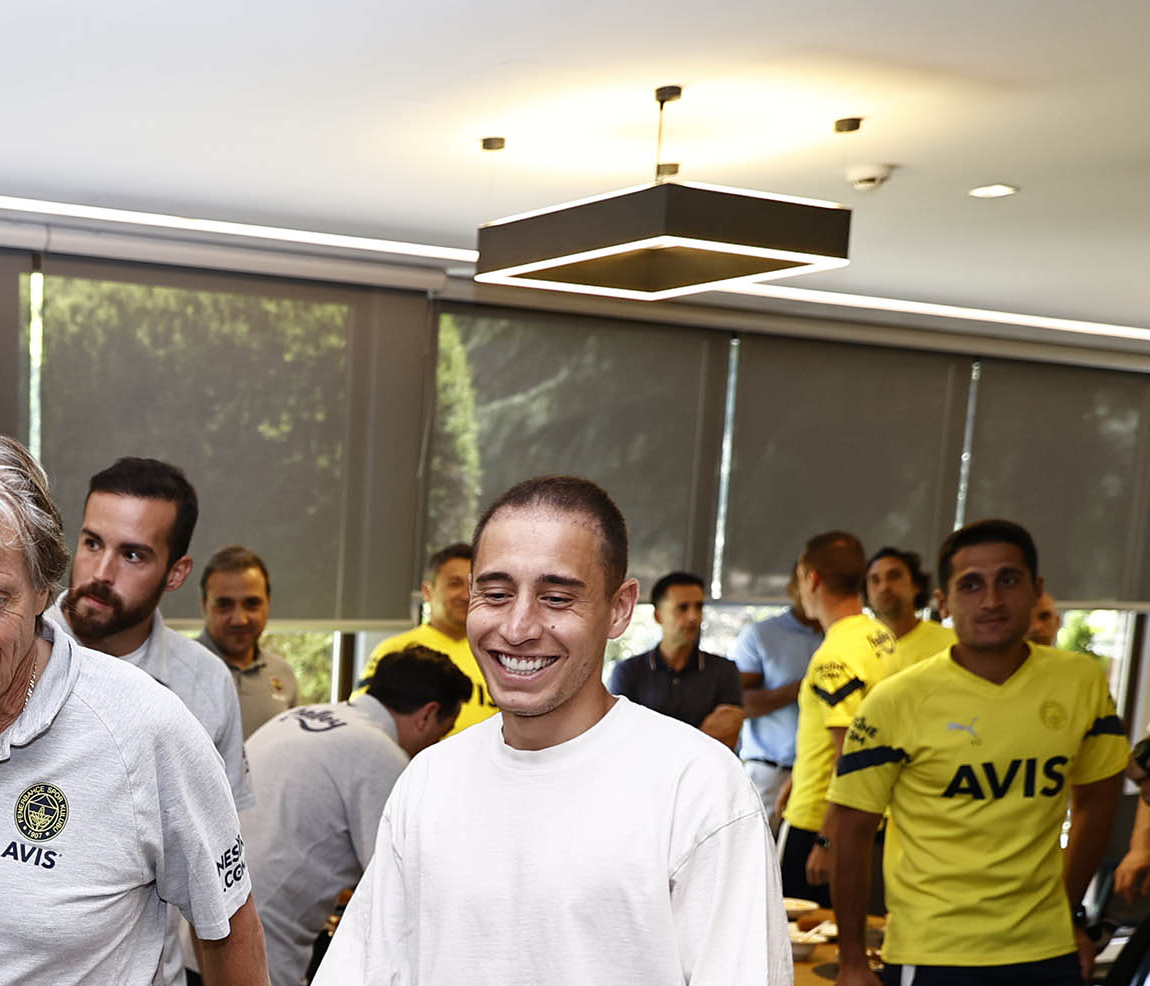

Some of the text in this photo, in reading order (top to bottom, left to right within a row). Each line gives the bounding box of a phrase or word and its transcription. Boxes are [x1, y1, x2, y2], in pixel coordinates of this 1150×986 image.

[940, 755, 1069, 800] AVIS
[47, 786, 64, 804] SPOR
[27, 829, 43, 839] 1907
[0, 841, 58, 869] AVIS
[223, 861, 245, 893] .CO
